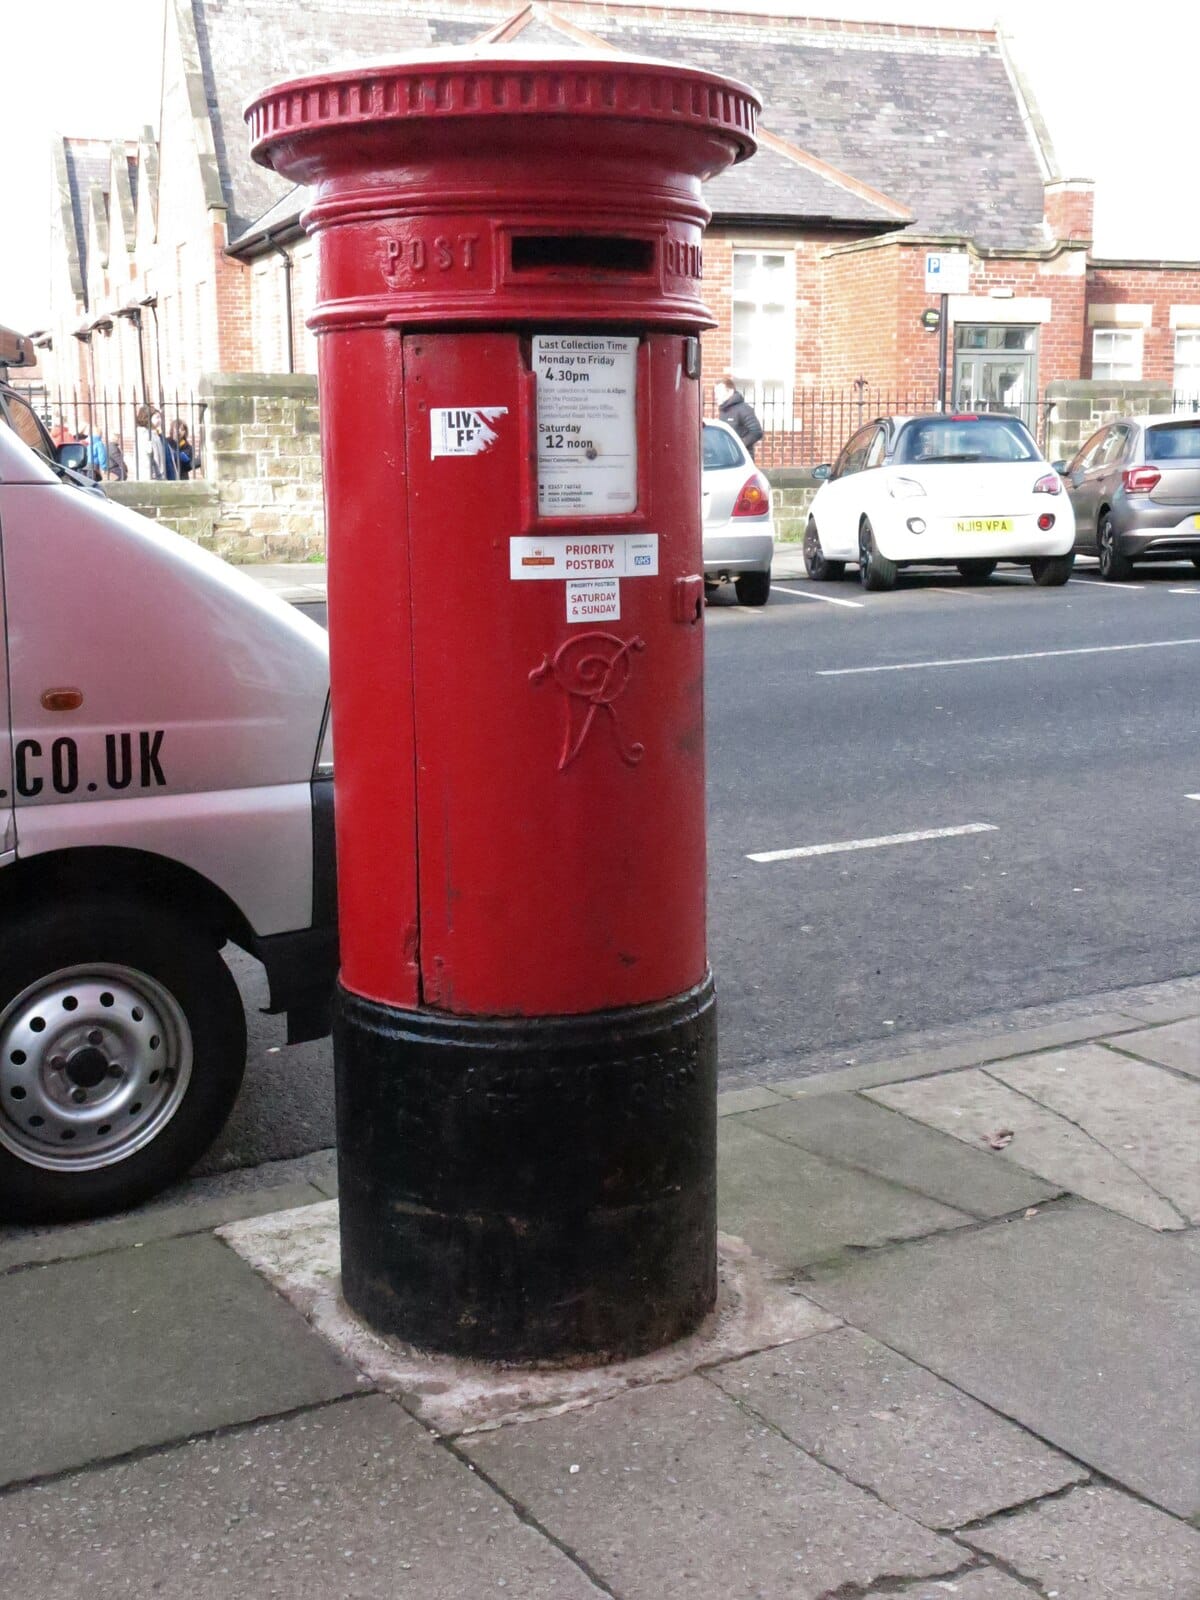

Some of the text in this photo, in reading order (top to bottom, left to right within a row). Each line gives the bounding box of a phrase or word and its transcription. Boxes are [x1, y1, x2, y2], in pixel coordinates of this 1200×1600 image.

[377, 233, 479, 277] POST
[930, 258, 940, 273] P
[539, 339, 628, 351] Last Collection Time
[539, 355, 615, 367] Monday to Friday
[545, 367, 590, 383] 4.30pm
[539, 424, 582, 434] Saturday
[545, 434, 593, 449] 12 noon
[957, 520, 1008, 532] NJ19 VPA
[566, 544, 615, 555] PRIORITY
[566, 559, 615, 570] POSTBOX
[571, 592, 616, 603] SATURDAY
[572, 604, 616, 615] & SUNDAY
